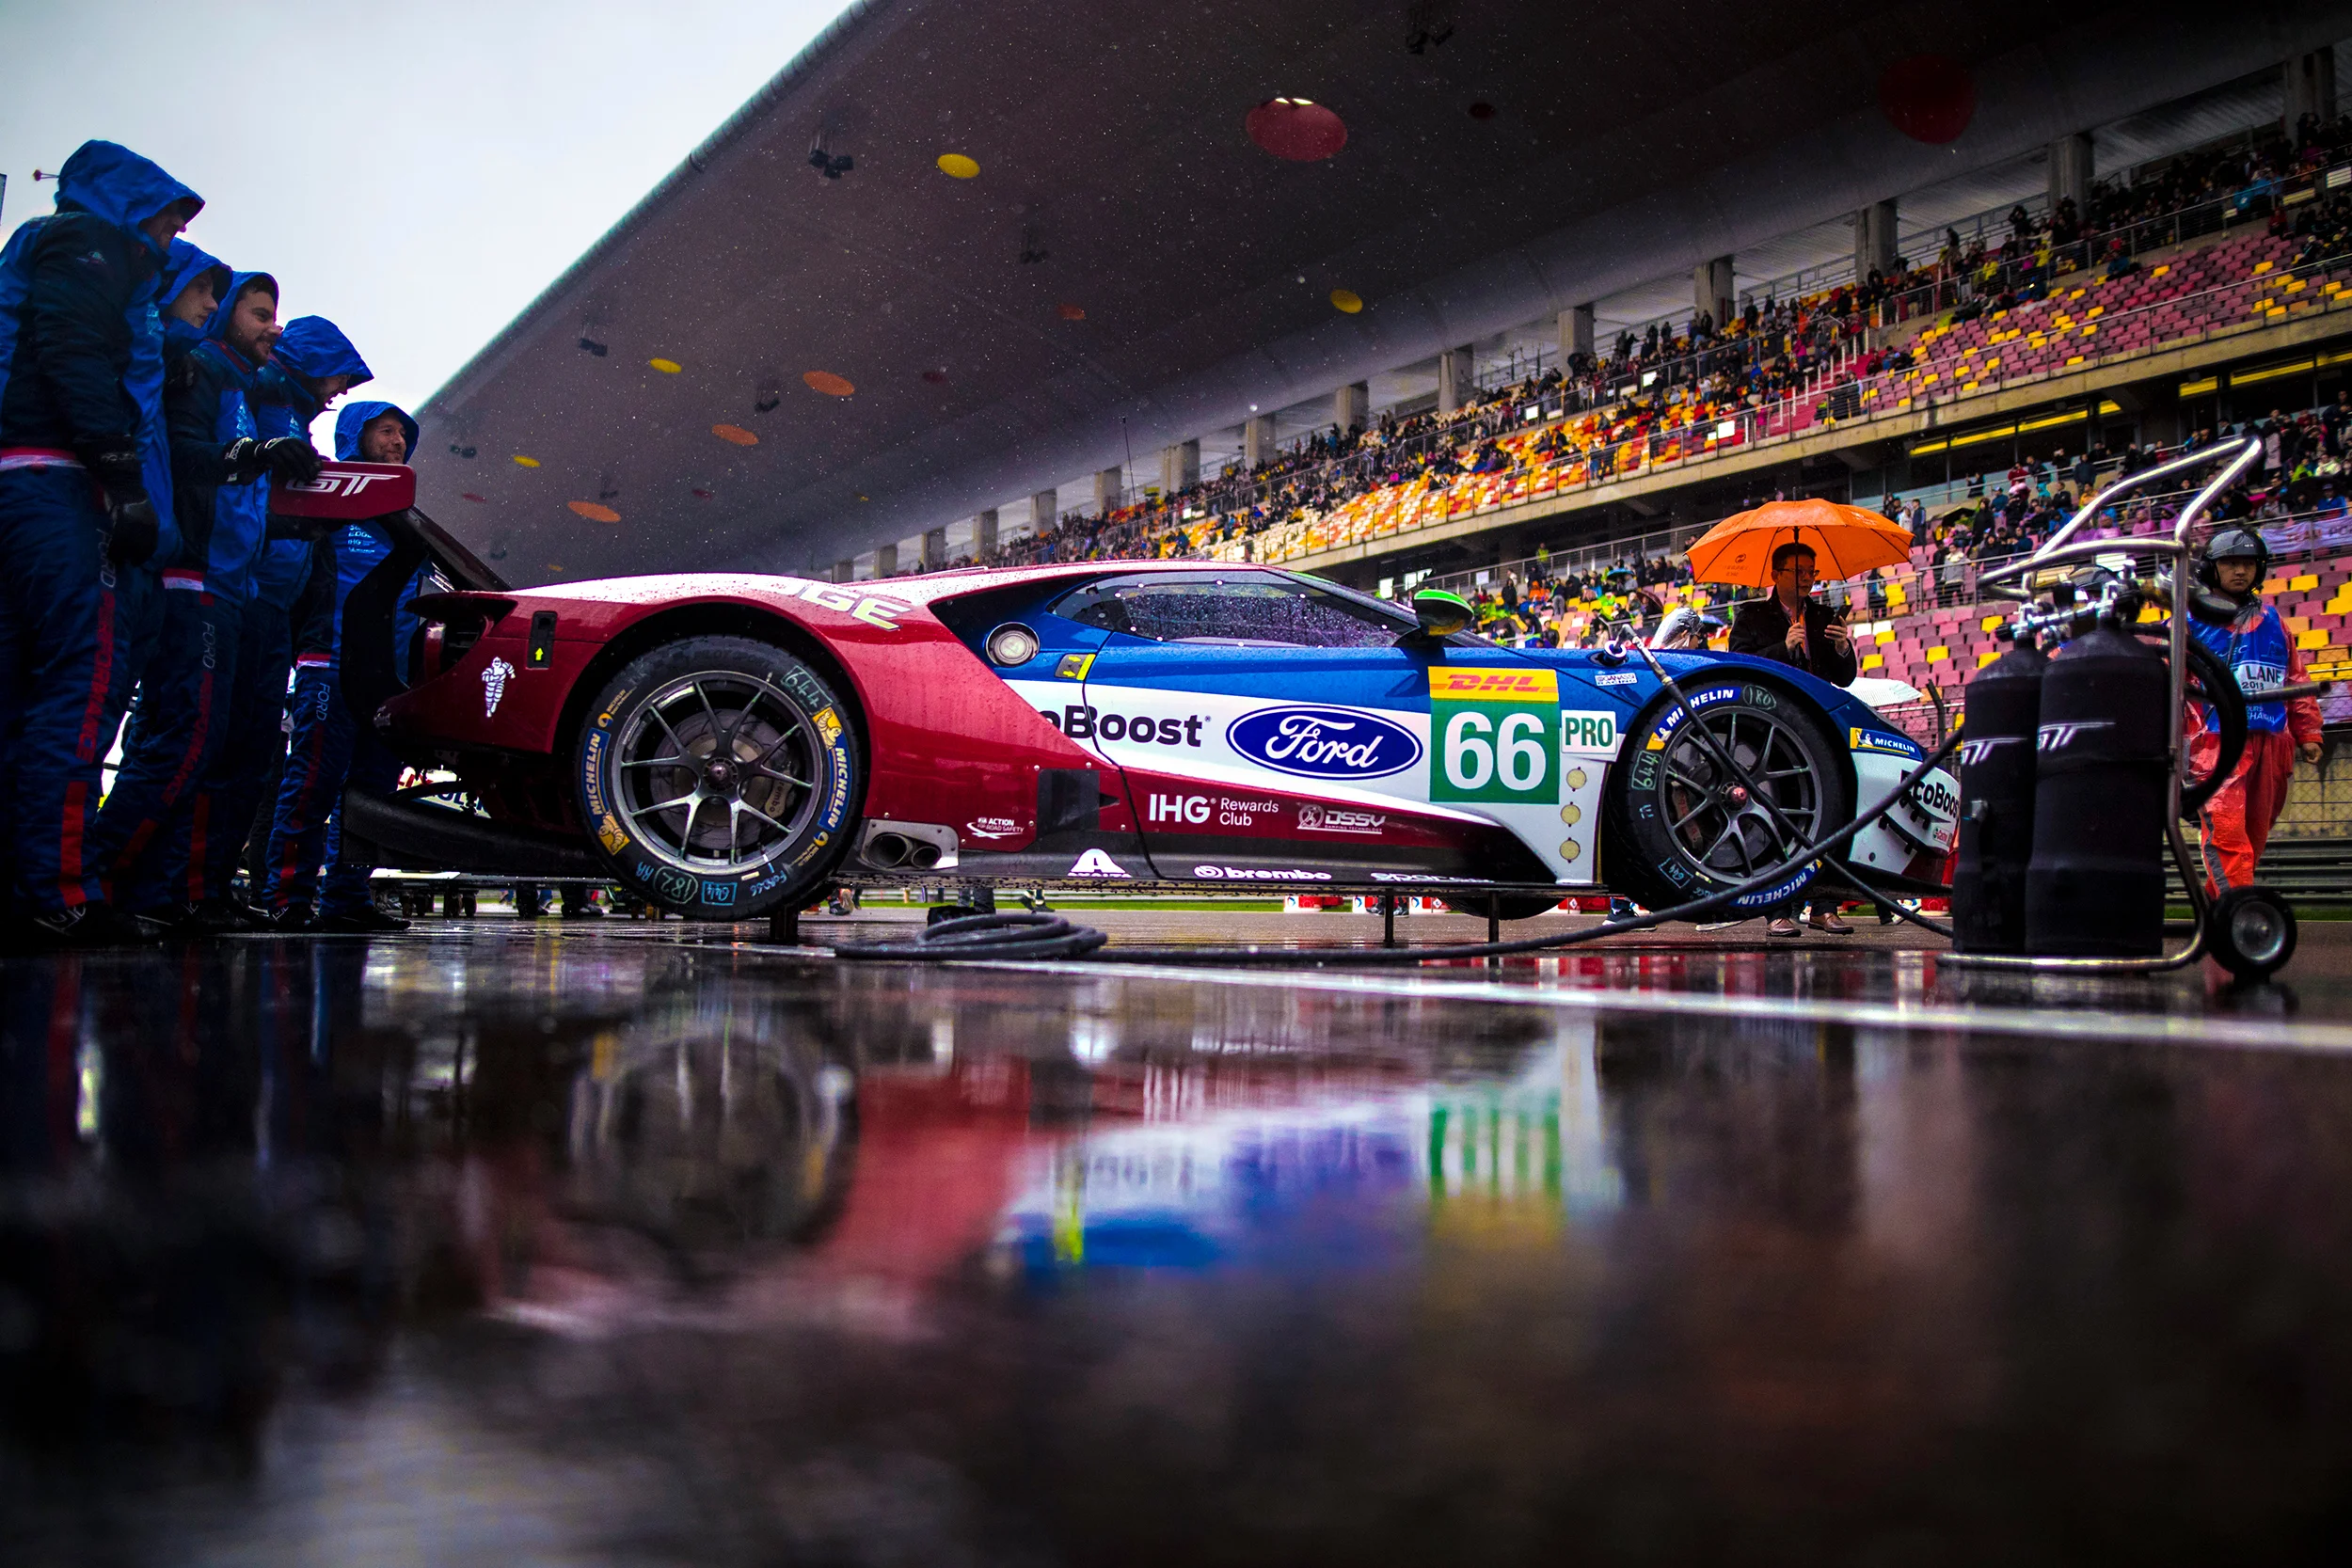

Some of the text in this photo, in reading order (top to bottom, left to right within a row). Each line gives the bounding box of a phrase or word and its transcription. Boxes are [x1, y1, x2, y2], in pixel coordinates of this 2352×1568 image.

[202, 620, 216, 670] FORD
[1448, 673, 1541, 692] DHL
[1748, 686, 1772, 705] 180
[316, 682, 331, 721] FORD
[1666, 689, 1734, 728] MIHELIN
[1264, 713, 1385, 768] Ford
[1565, 717, 1613, 748] PRO
[1875, 738, 1915, 752] MICHELIN
[1444, 711, 1547, 791] 66
[585, 733, 601, 816] MICHELIN
[1633, 753, 1659, 787] 644
[770, 781, 786, 814] rembo
[828, 748, 849, 829] MICHELIN
[1149, 794, 1210, 824] IHG
[1219, 811, 1252, 827] Club
[1220, 797, 1279, 814] Rewards
[1325, 810, 1386, 828] DSSV
[988, 817, 1014, 826] ACTION
[661, 871, 693, 901] 182
[1224, 865, 1332, 880] brembo
[1737, 873, 1807, 905] MICHELIN
